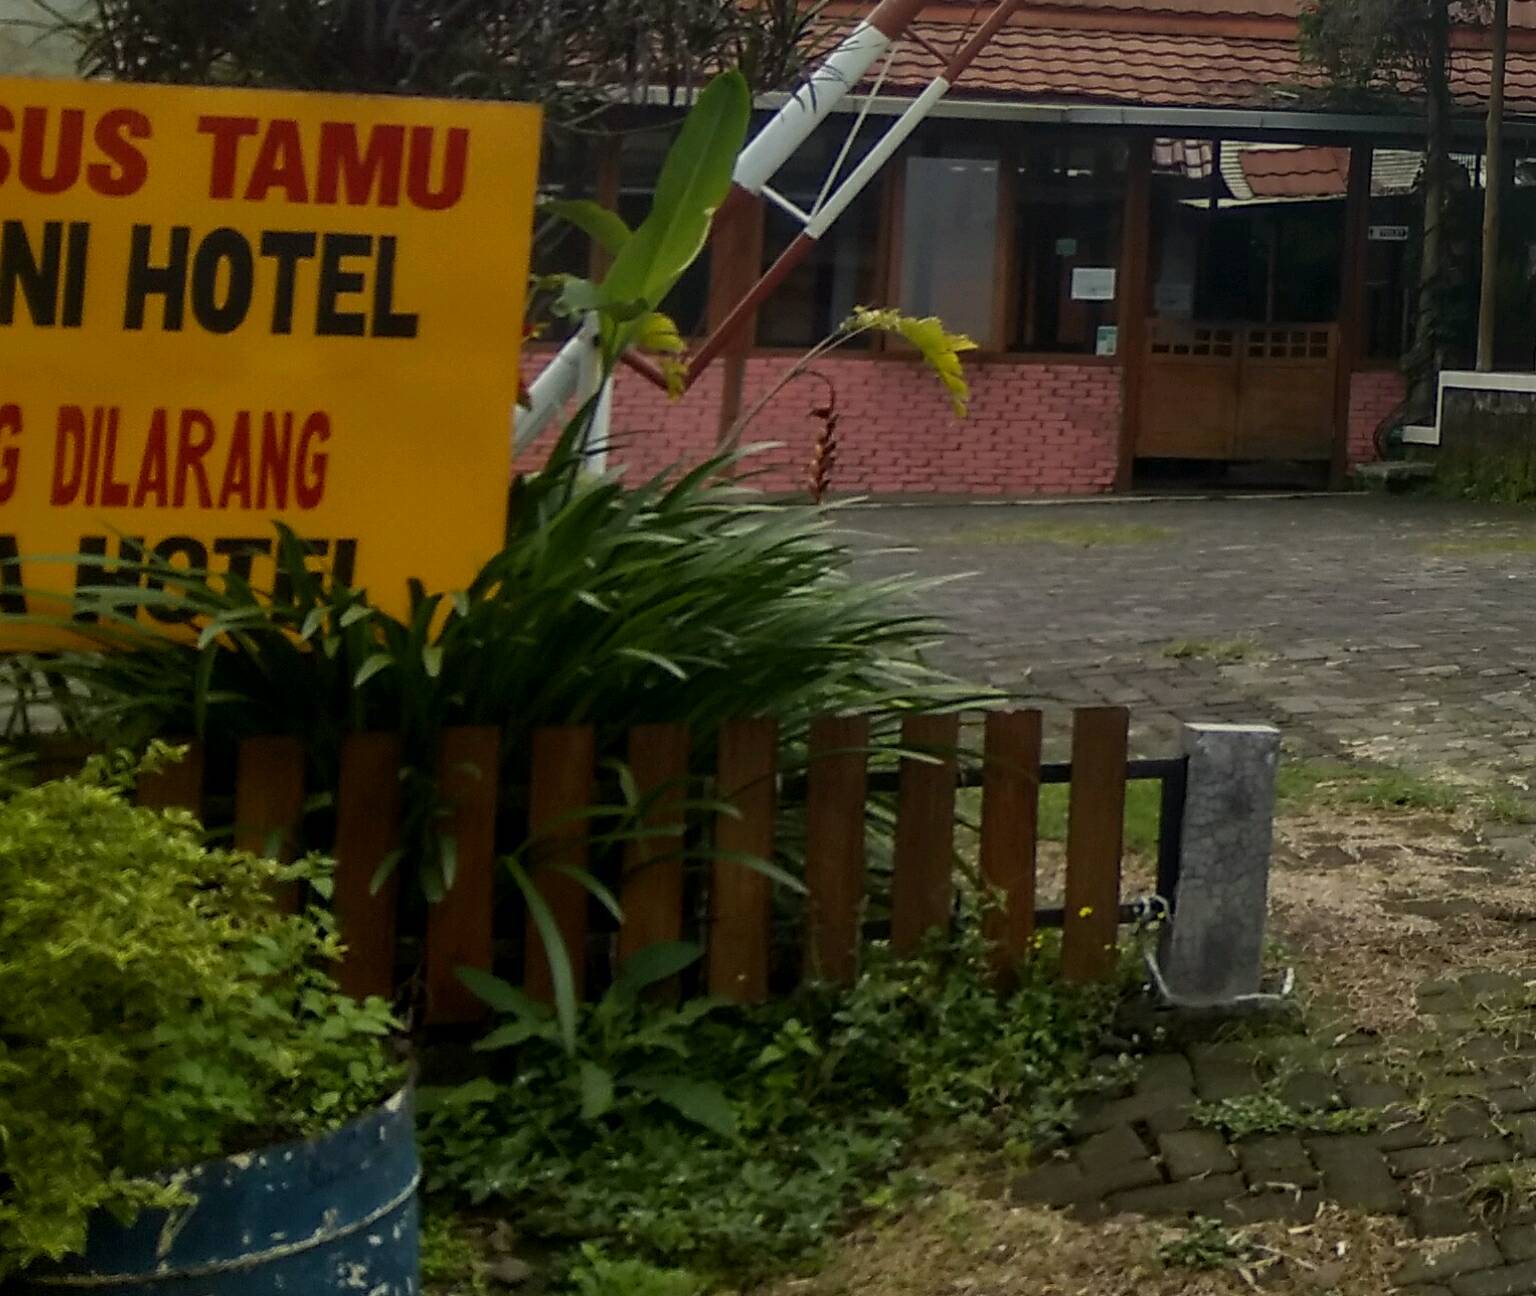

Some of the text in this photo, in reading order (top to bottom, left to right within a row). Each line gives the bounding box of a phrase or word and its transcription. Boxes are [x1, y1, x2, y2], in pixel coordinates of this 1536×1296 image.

[0, 106, 470, 211] US TAMU
[123, 223, 419, 340] HOTEL
[49, 405, 332, 511] DILARANG
